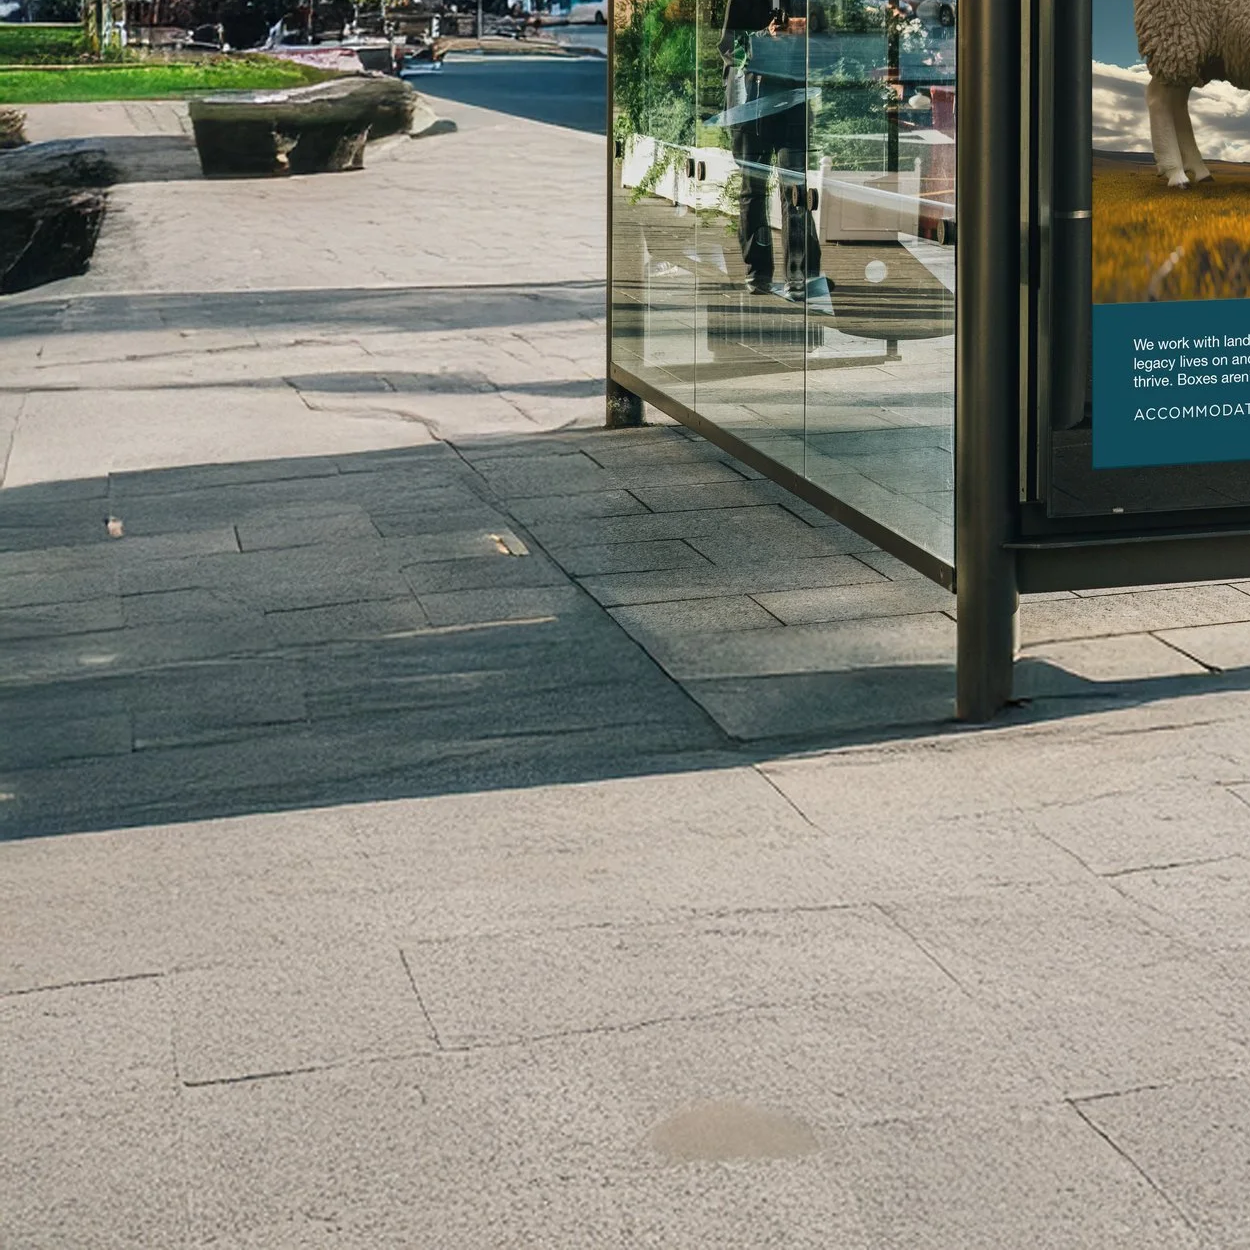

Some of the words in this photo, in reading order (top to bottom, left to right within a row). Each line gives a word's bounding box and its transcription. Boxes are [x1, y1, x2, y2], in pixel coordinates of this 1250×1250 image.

[1134, 339, 1154, 350] We
[1158, 337, 1189, 349] work
[1194, 336, 1219, 348] with
[1134, 358, 1175, 372] legacy
[1181, 356, 1208, 367] lives
[1212, 357, 1227, 365] on
[1134, 375, 1172, 387] thrive.
[1178, 374, 1217, 385] Boxes
